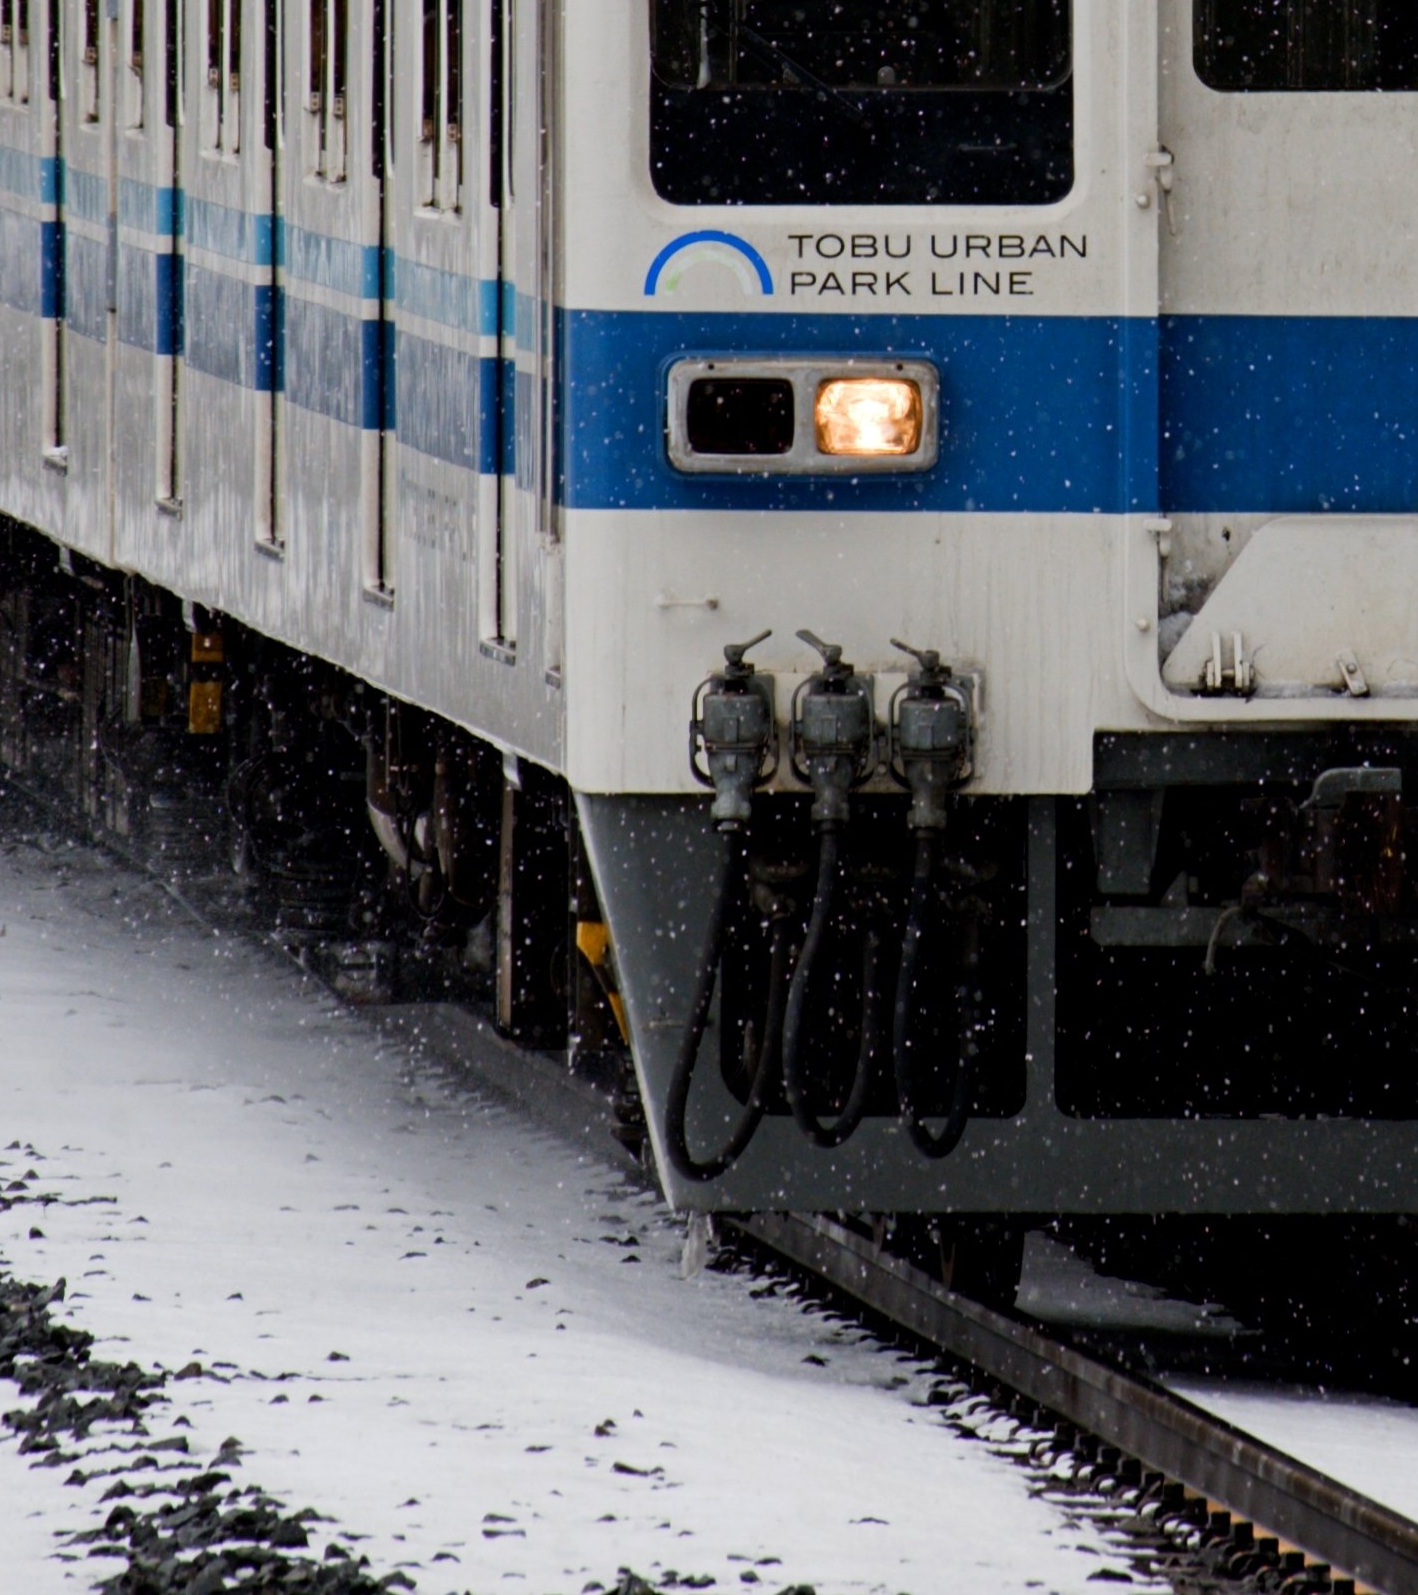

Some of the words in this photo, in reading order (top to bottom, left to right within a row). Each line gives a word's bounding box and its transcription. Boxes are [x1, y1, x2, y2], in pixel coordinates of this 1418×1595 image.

[787, 233, 912, 260] TOBU
[930, 233, 1088, 260] URBAN
[789, 270, 913, 297] PARK
[930, 270, 1035, 297] LINE
